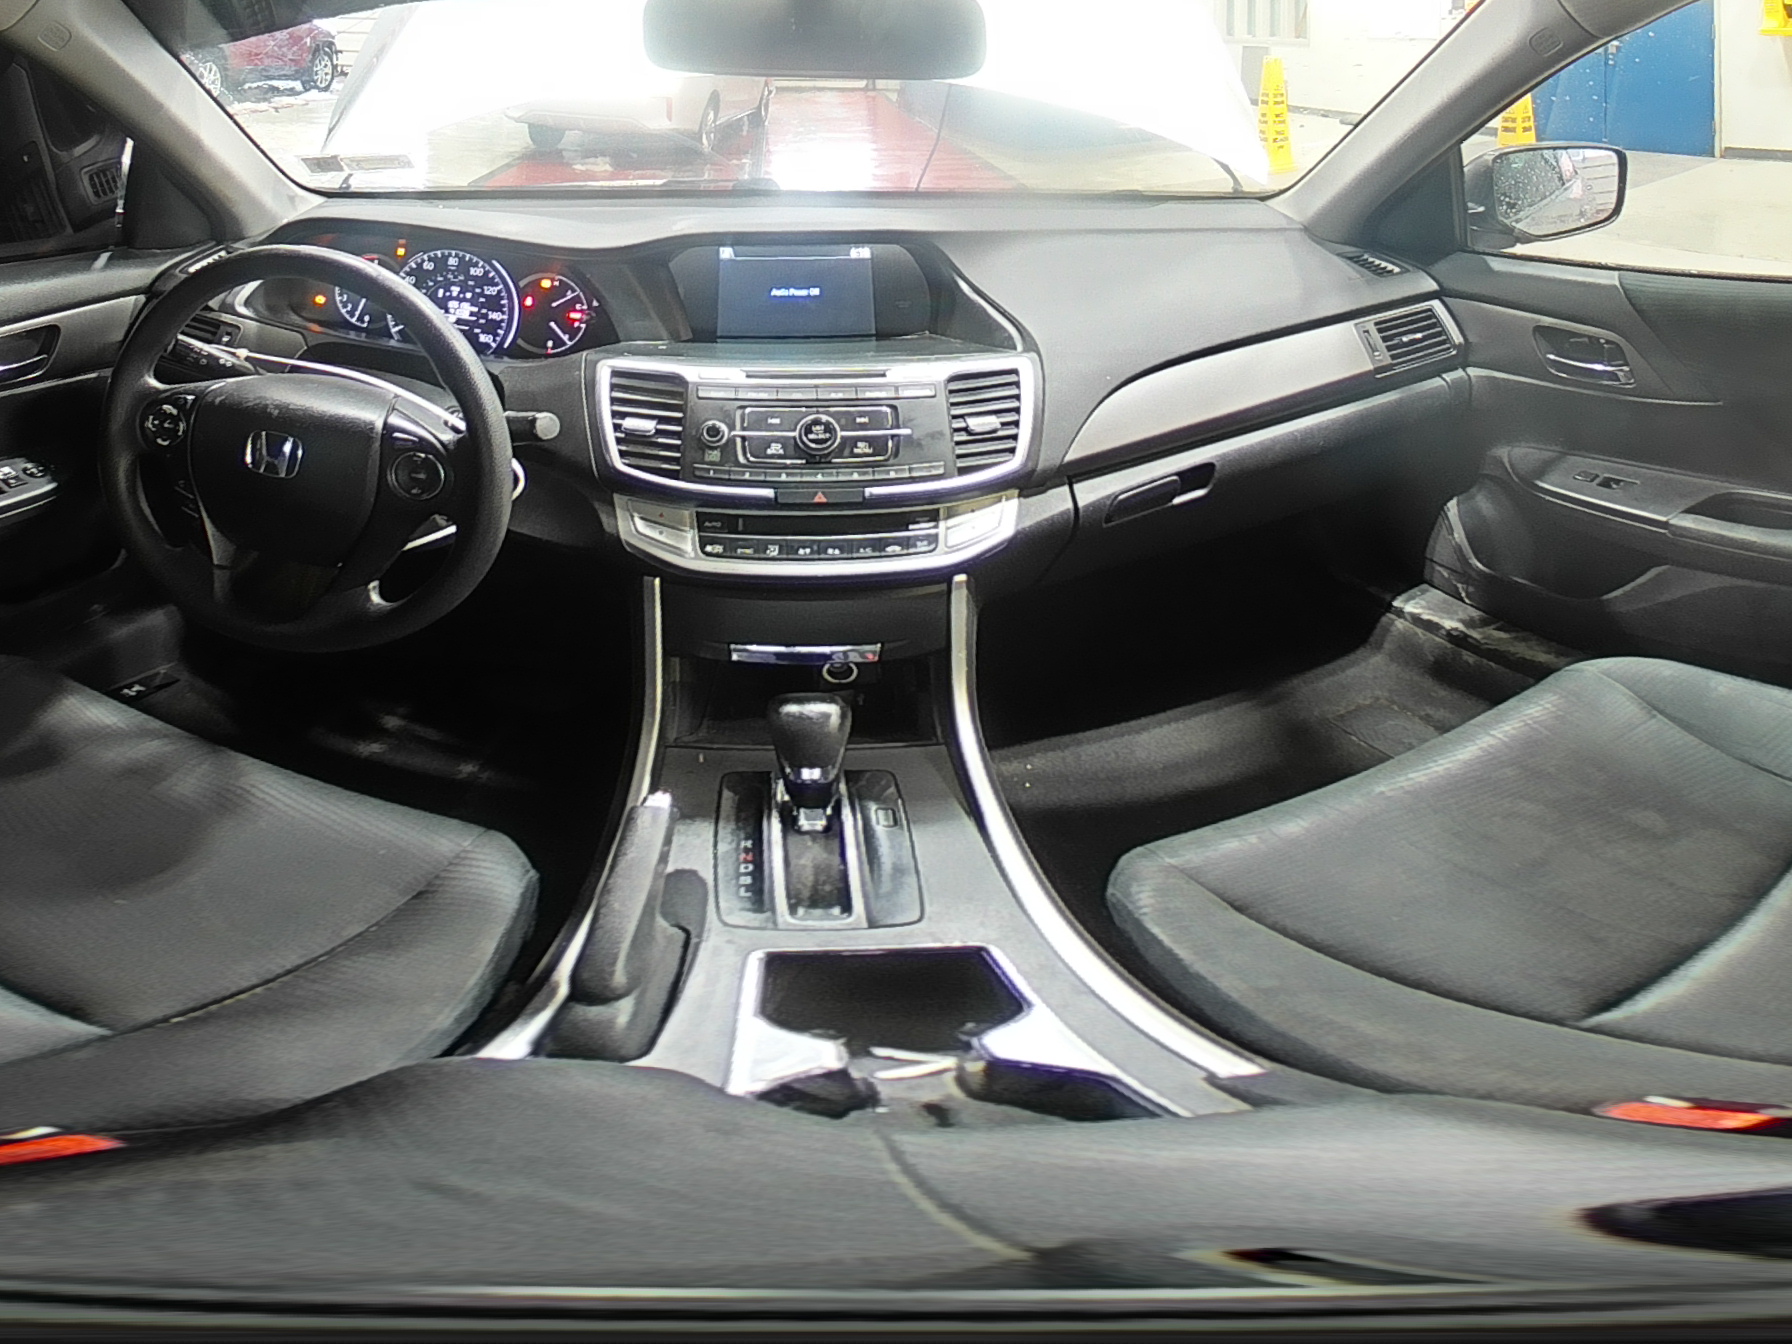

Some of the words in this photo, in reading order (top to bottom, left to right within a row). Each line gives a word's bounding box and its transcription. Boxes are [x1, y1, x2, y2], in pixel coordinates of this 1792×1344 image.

[422, 261, 435, 271] 60
[447, 257, 459, 266] 80
[469, 267, 484, 276] 100
[483, 286, 498, 295] 120
[487, 311, 502, 321] 140
[478, 333, 493, 343] 160
[739, 863, 754, 873] D
[739, 886, 753, 897] L
